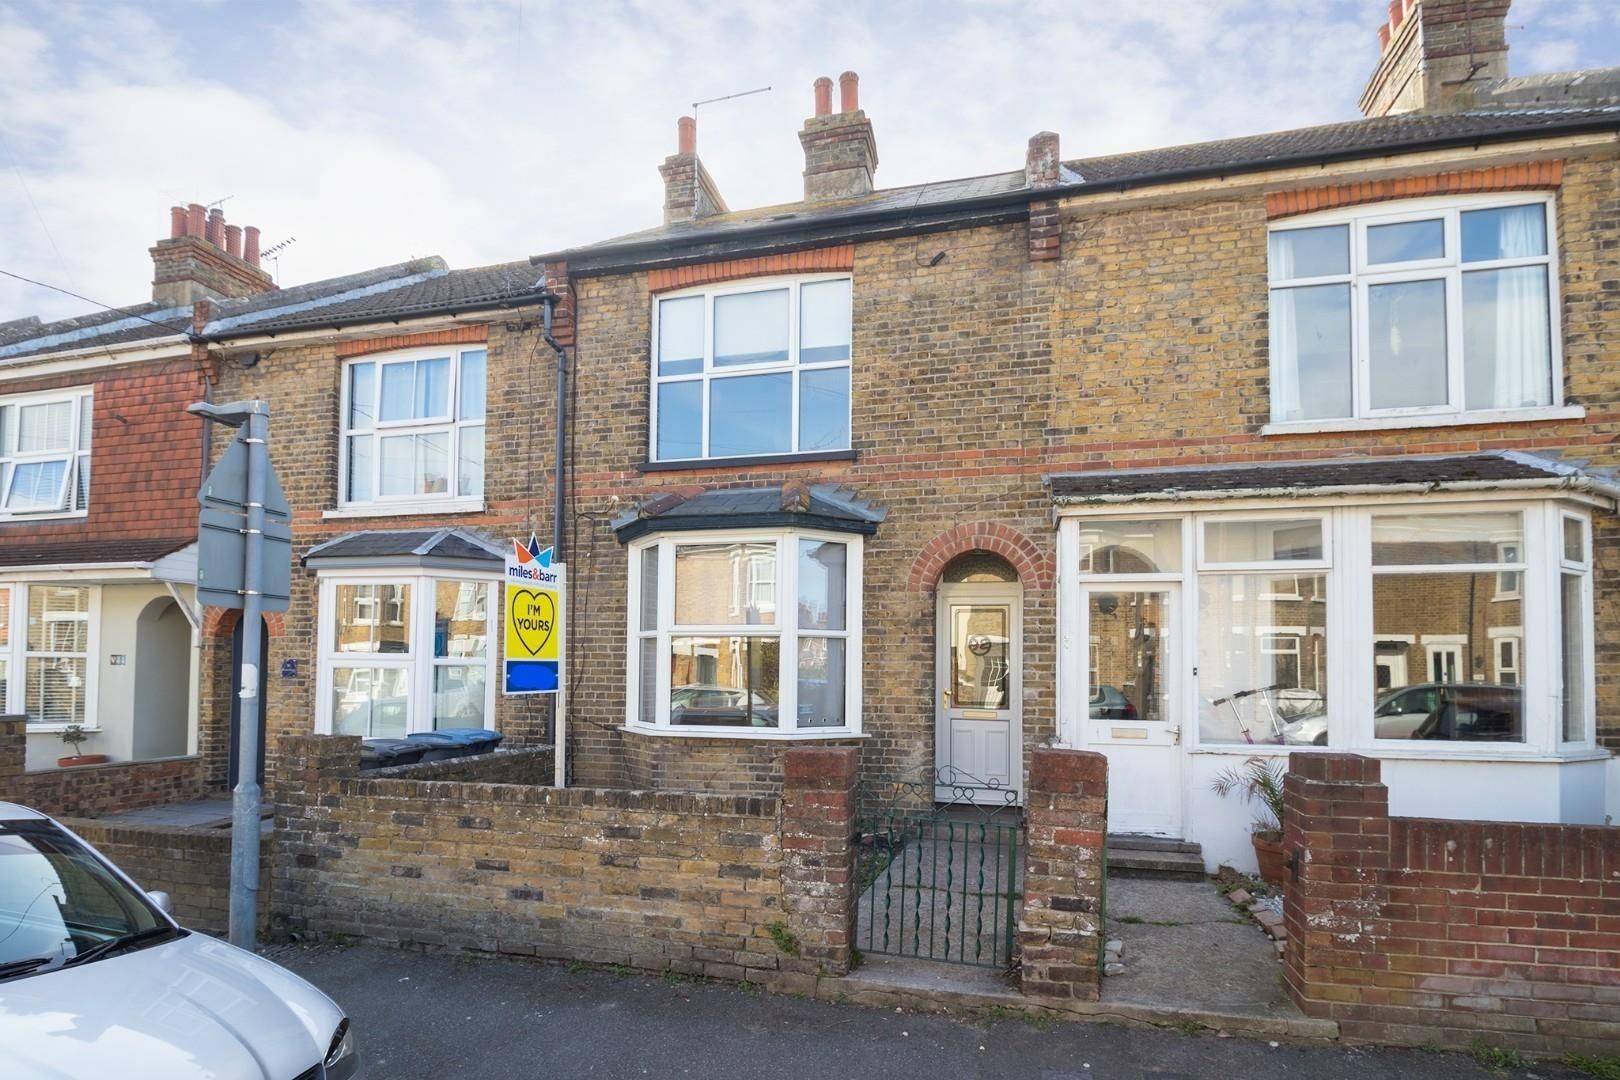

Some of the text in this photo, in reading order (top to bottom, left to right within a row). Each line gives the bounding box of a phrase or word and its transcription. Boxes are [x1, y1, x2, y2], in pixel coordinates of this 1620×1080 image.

[509, 565, 557, 582] miles&barr
[527, 604, 541, 616] I'M
[517, 618, 550, 631] YOURS
